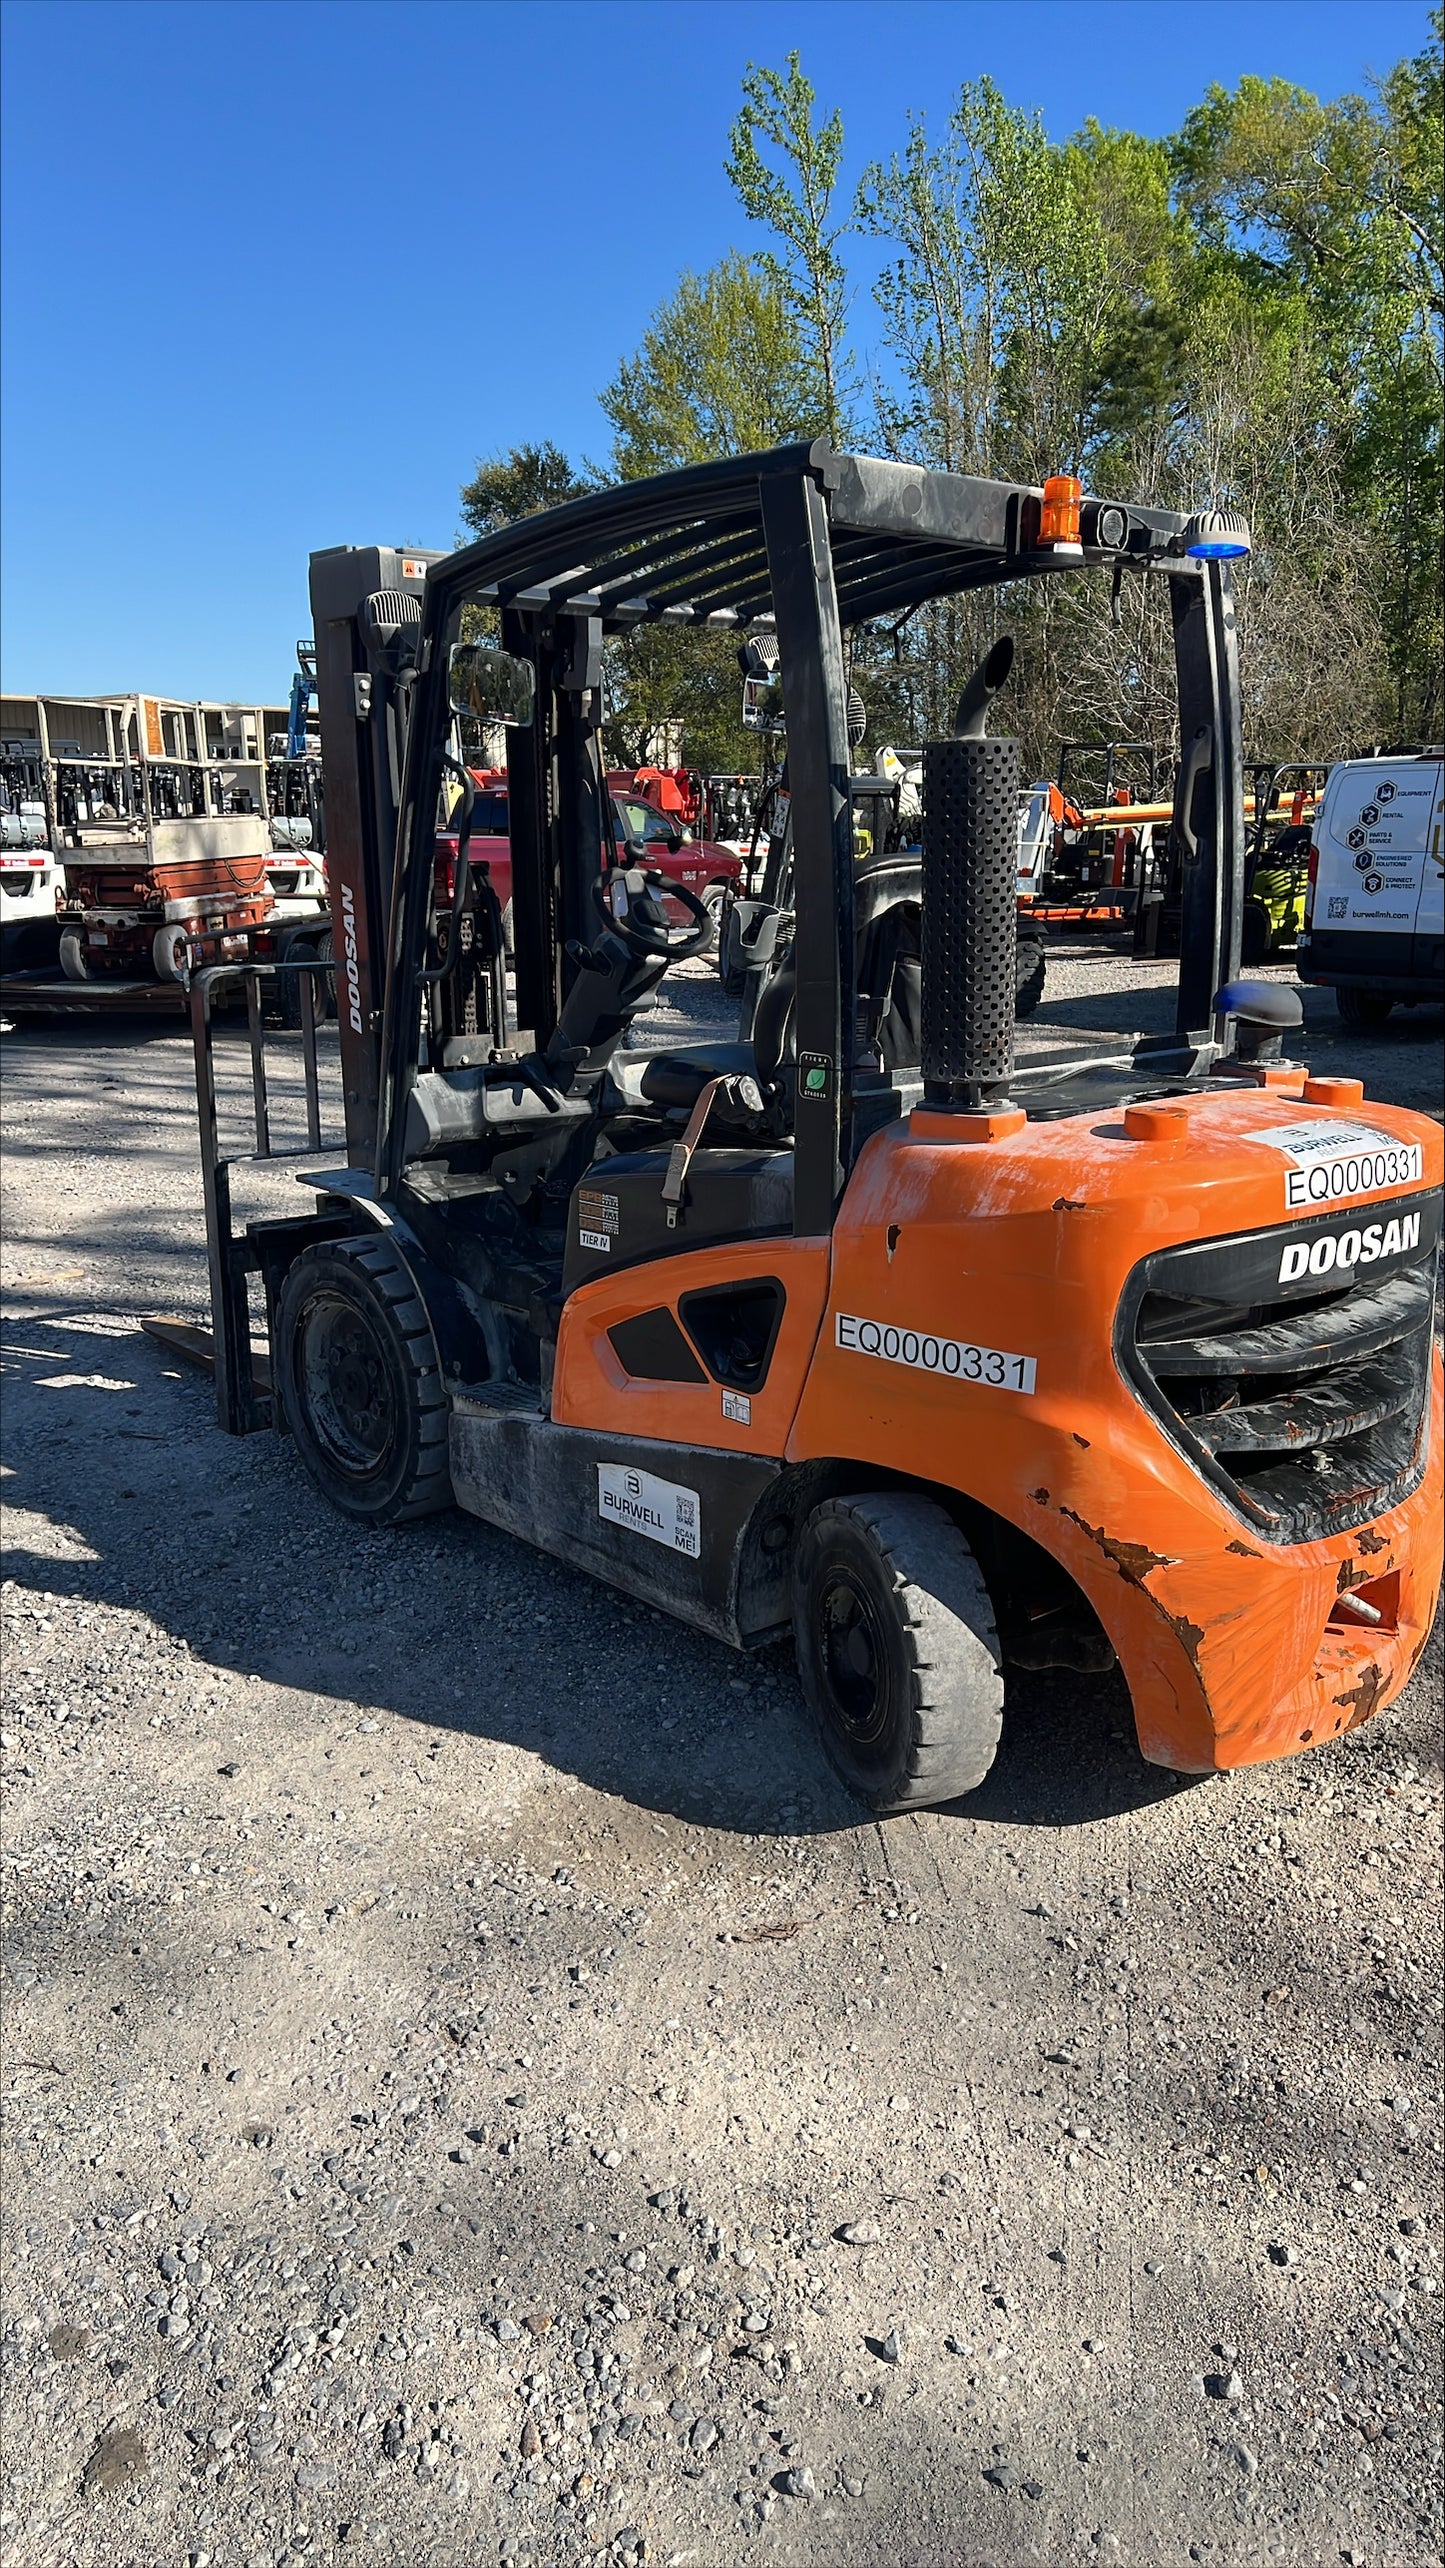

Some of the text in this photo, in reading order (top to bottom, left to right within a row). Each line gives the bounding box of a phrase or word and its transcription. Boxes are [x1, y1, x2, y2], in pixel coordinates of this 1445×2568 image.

[1352, 911, 1409, 920] burwellmh.com
[341, 883, 363, 1035] DOOSAN
[1282, 1133, 1363, 1154] BURWELL
[1289, 1147, 1418, 1205] EQ0000331
[582, 1233, 608, 1248] TIER IV
[1278, 1211, 1421, 1284] DOOSAN
[839, 1315, 1026, 1390] EQ0000331
[603, 1490, 665, 1530] BURWELL
[619, 1512, 648, 1531] RENTS
[674, 1526, 695, 1542] SCAN
[674, 1535, 696, 1553] ME!
